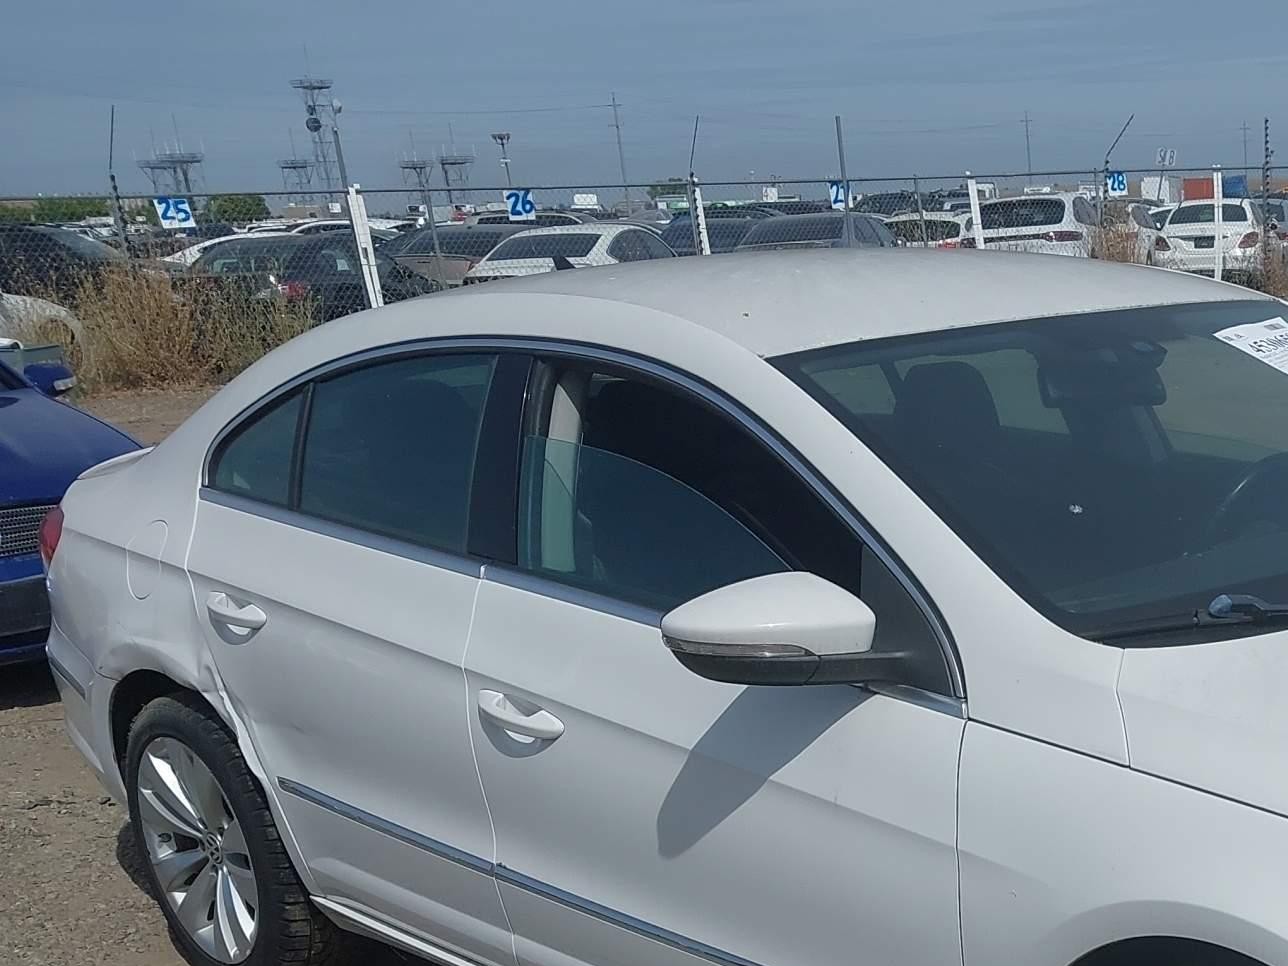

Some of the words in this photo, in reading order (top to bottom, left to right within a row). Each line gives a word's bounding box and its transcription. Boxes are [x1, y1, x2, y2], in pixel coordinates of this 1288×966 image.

[1107, 171, 1126, 192] 28
[157, 196, 190, 222] 25
[506, 189, 535, 216] 26
